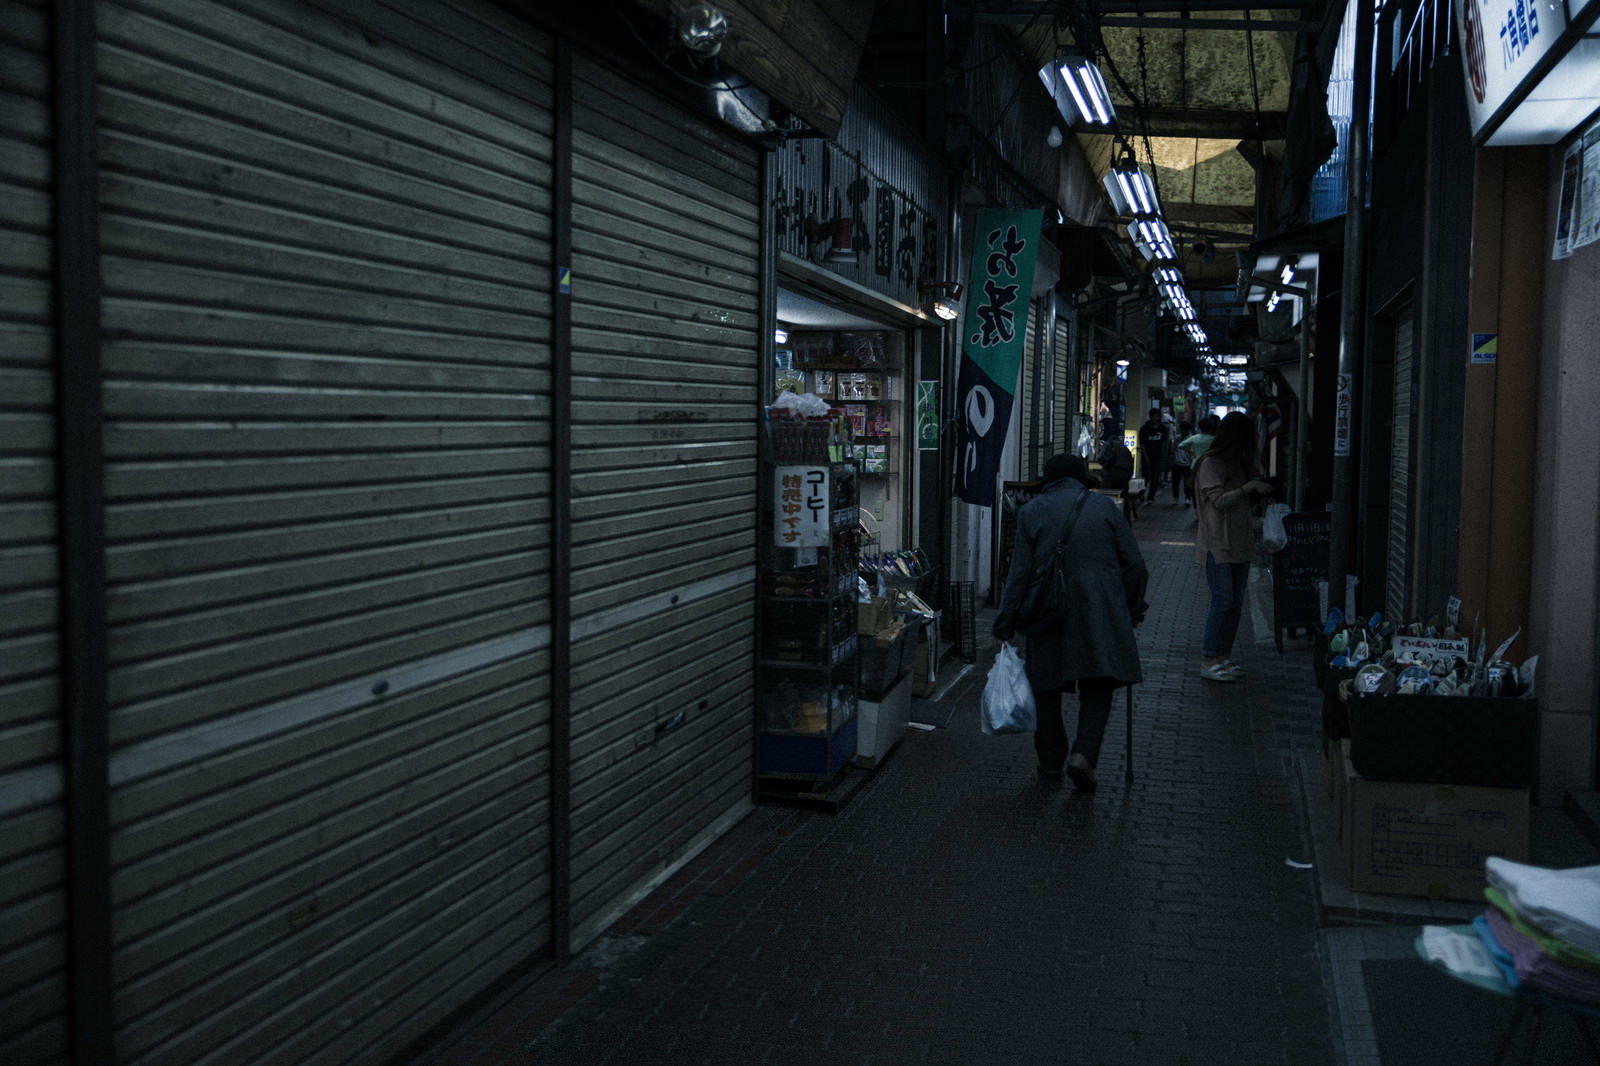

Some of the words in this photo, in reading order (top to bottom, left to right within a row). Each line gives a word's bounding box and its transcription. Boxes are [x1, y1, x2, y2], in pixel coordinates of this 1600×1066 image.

[782, 473, 802, 544] 特売中です
[807, 470, 825, 523] コーヒー
